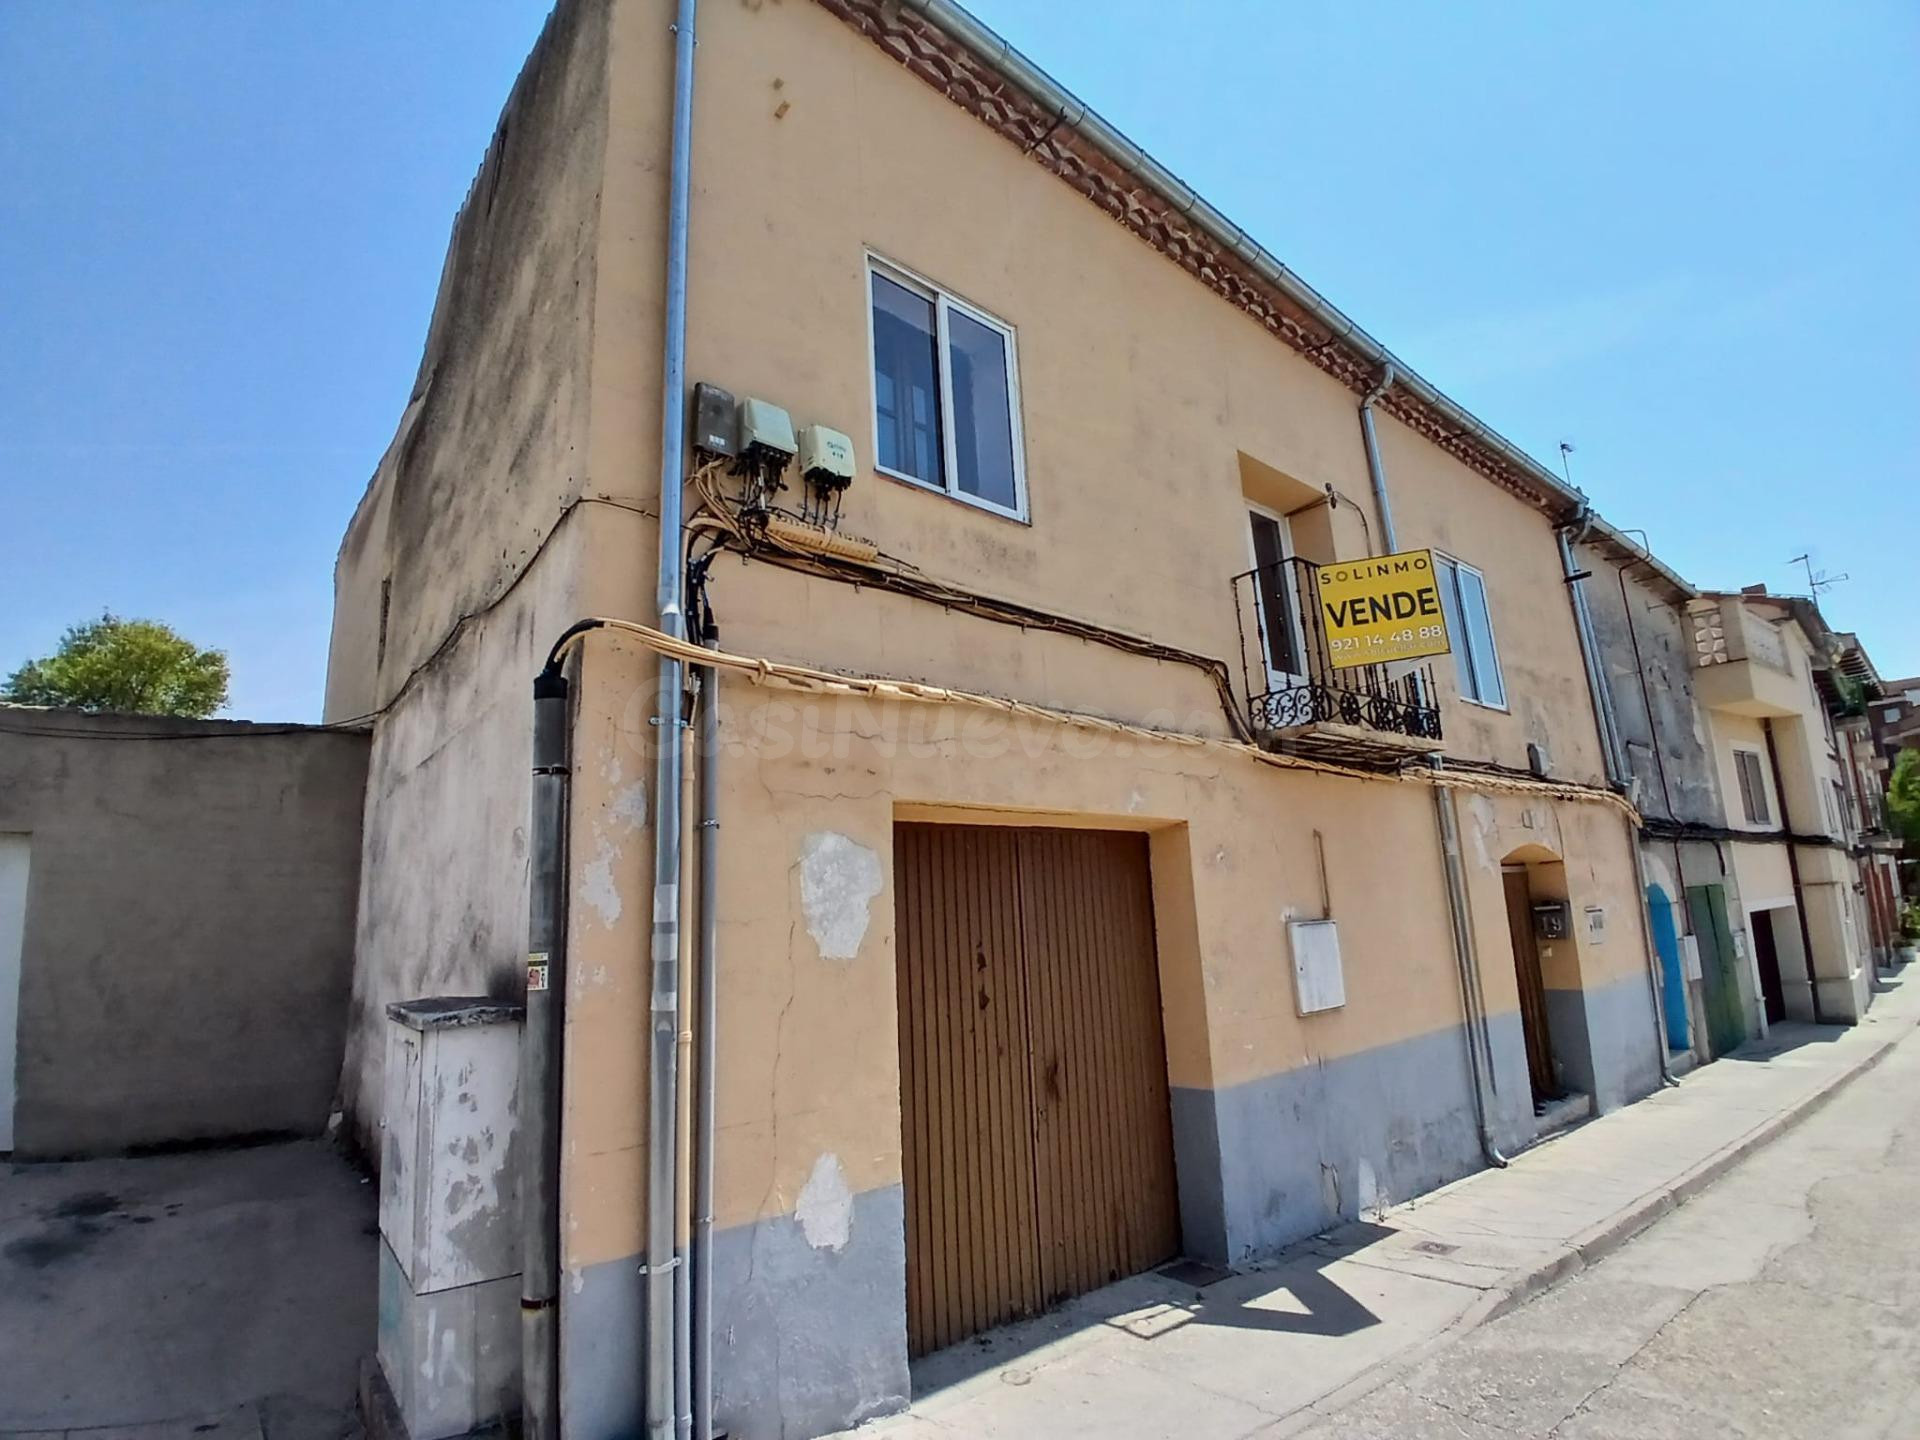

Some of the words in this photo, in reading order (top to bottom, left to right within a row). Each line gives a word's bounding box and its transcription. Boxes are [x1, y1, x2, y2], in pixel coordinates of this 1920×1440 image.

[1320, 558, 1427, 585] SOLINMO
[1325, 587, 1438, 628] VENDE
[1331, 637, 1360, 651] 921
[1365, 634, 1384, 647] 14
[1390, 629, 1414, 642] 48
[1419, 625, 1442, 639] 88
